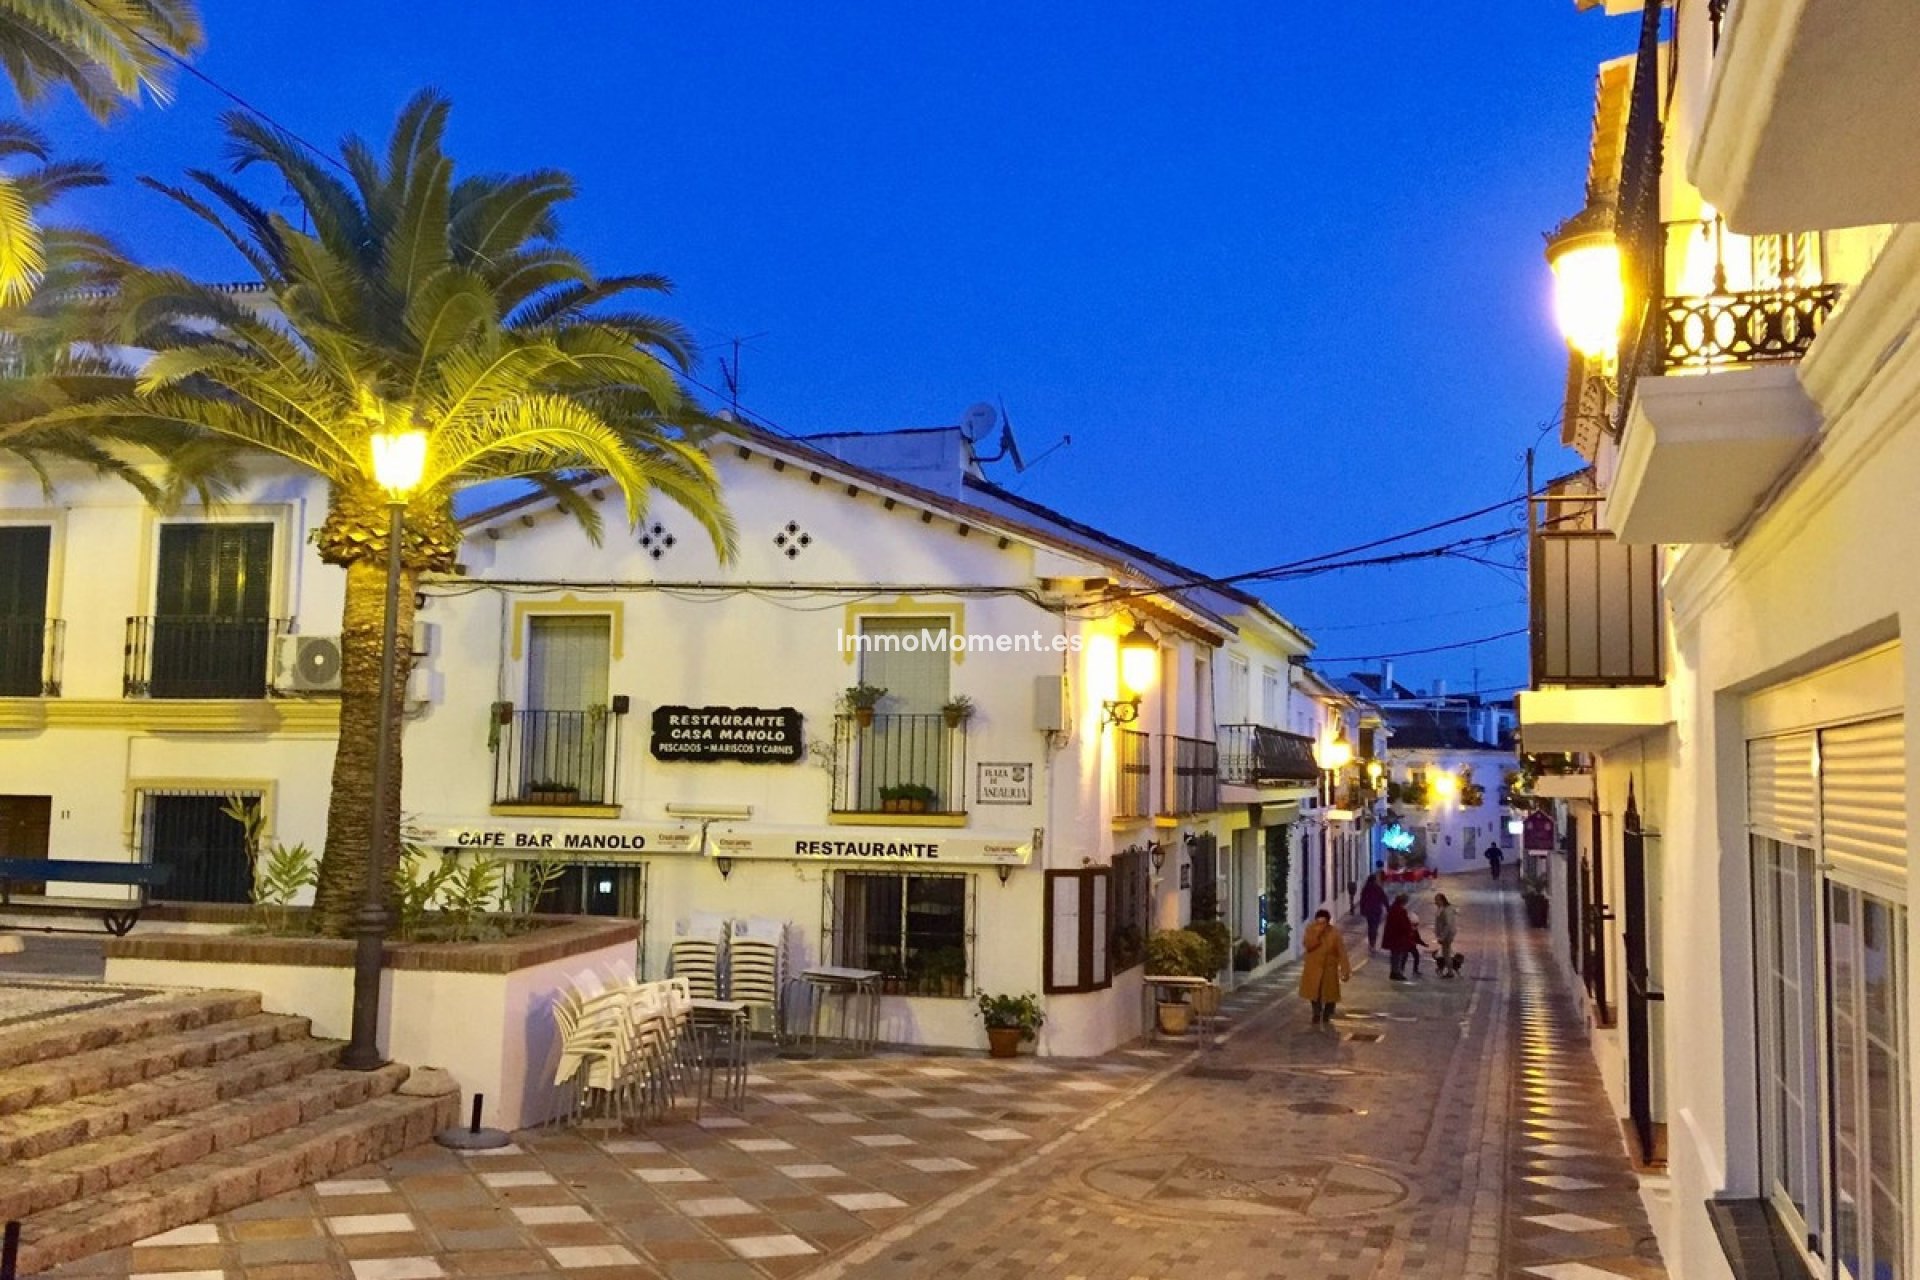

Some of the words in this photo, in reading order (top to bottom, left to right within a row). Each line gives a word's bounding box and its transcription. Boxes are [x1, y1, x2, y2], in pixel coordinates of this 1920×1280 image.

[669, 715, 785, 727] RESTAURANTE
[671, 729, 713, 740] CASA
[719, 730, 785, 741] MANOLO
[658, 743, 702, 753] PESCADOS
[762, 745, 794, 755] CARNES
[515, 833, 553, 847] BAR
[564, 834, 646, 849] MANOLO
[795, 840, 939, 858] RESTAURANTE
